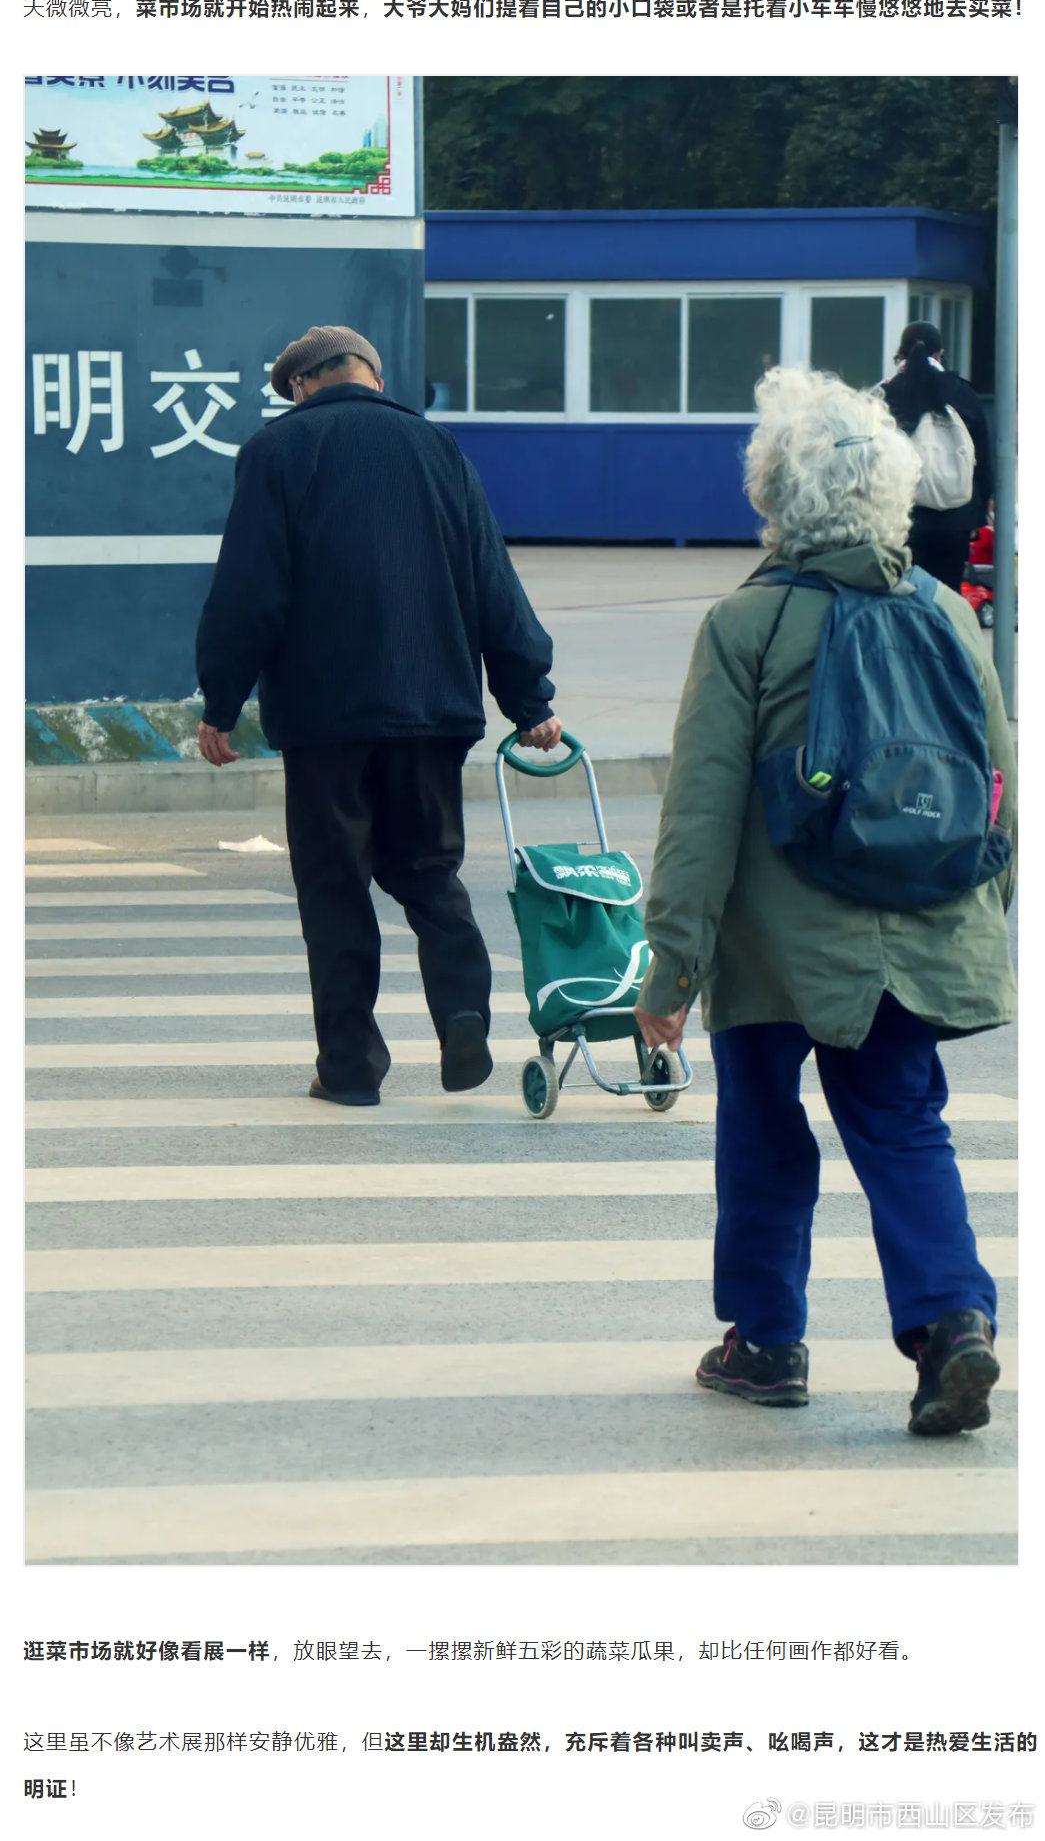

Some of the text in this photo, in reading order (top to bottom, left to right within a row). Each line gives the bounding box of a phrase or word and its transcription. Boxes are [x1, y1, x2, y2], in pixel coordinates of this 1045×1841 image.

[32, 349, 297, 460] 明交
[24, 1639, 910, 1662] 逛菜市场就好像看展一样，放眼望去，一摞摞新鲜五彩的蔬菜瓜果，却比任何画作都好看。
[24, 1730, 1038, 1753] 这里虽不像艺术展那样安静优雅，但这里却生机盎然，充斥着各种叫卖声、吆喝声，这才是热爱生活的
